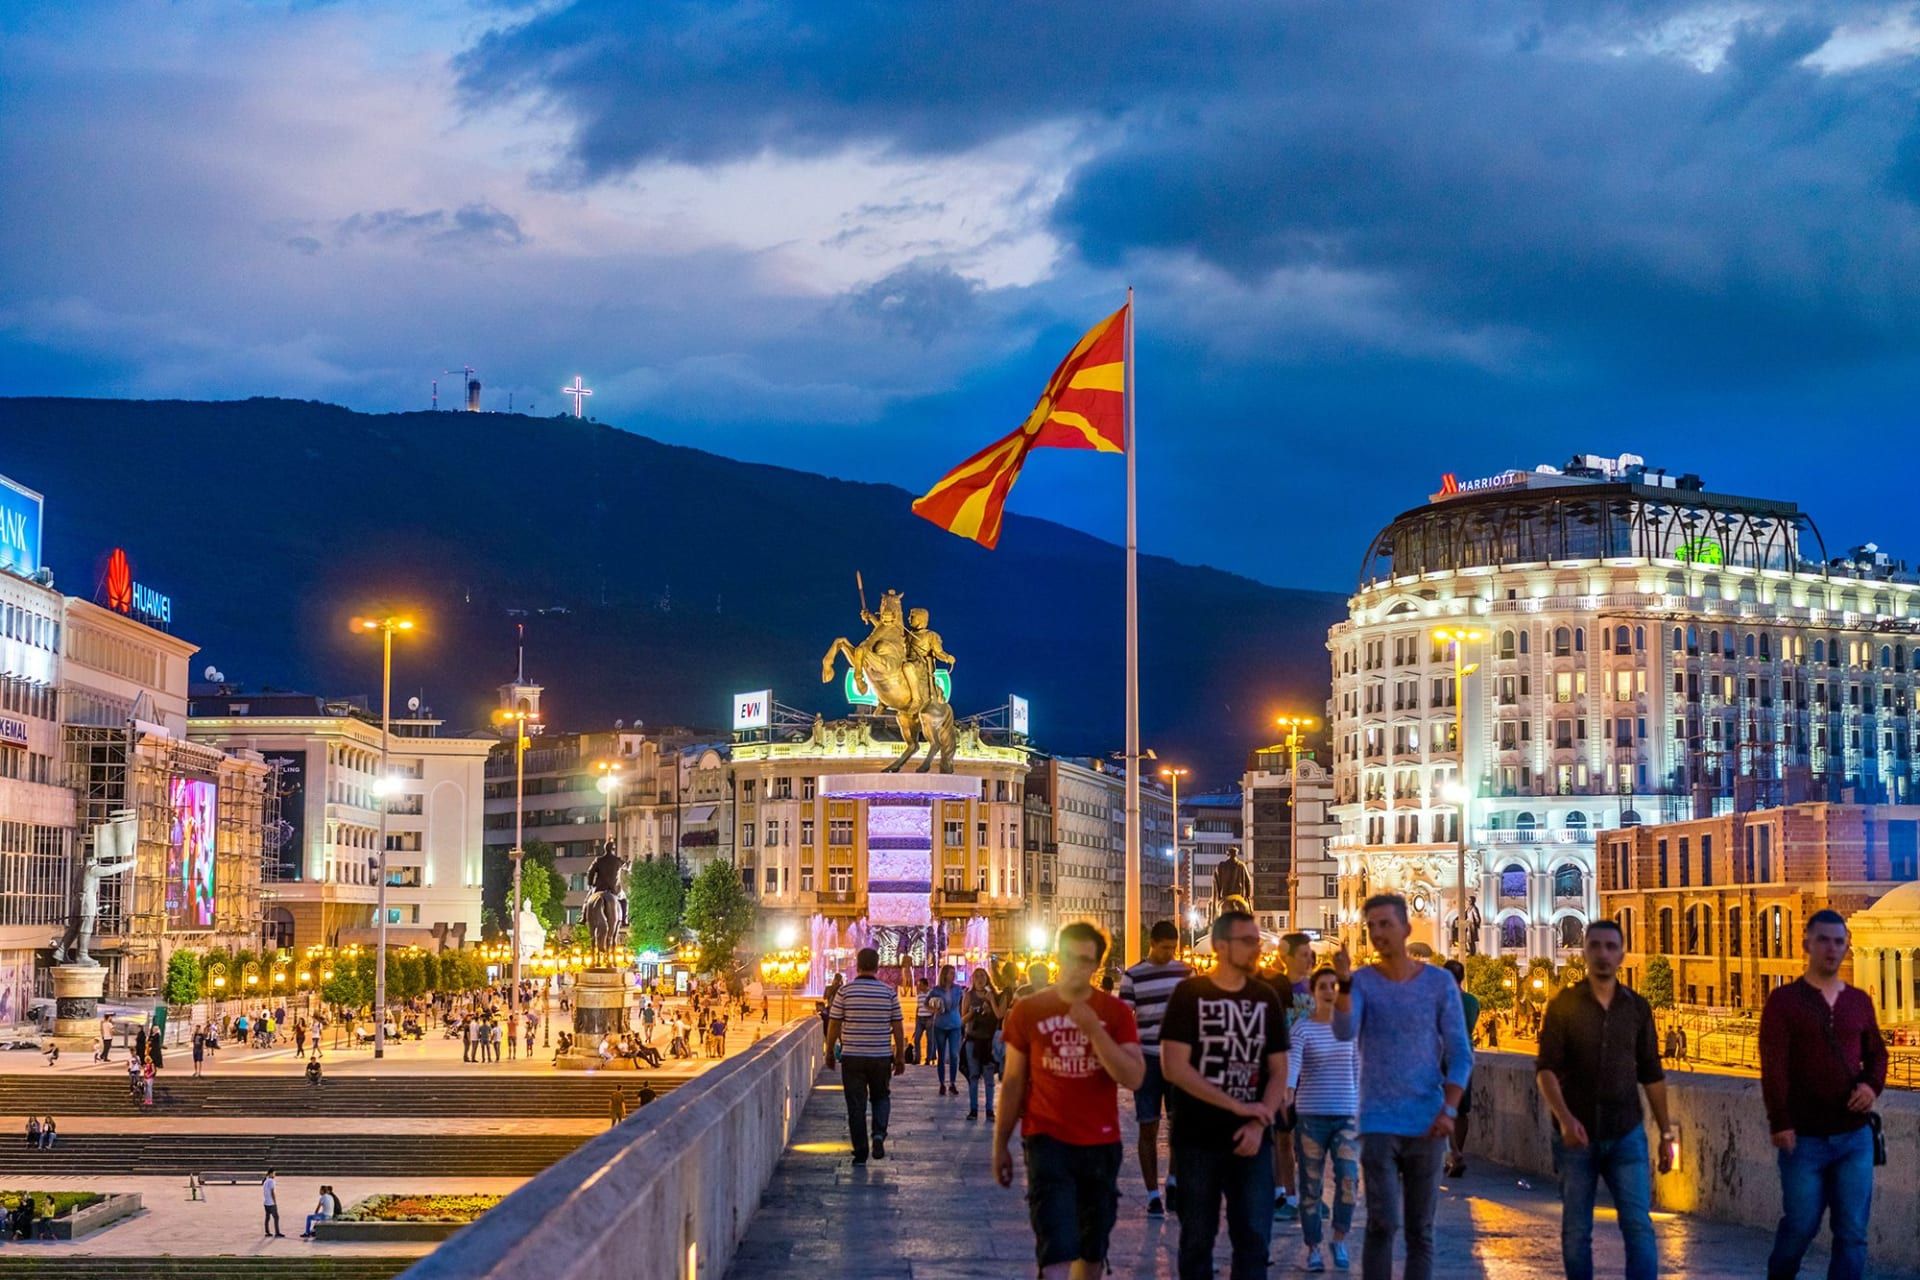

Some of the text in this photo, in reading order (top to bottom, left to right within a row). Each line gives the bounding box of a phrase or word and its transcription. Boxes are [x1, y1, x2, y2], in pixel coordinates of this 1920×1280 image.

[1458, 472, 1515, 492] MARRIOTT
[132, 581, 171, 623] HUAWEI
[741, 701, 761, 718] EVN
